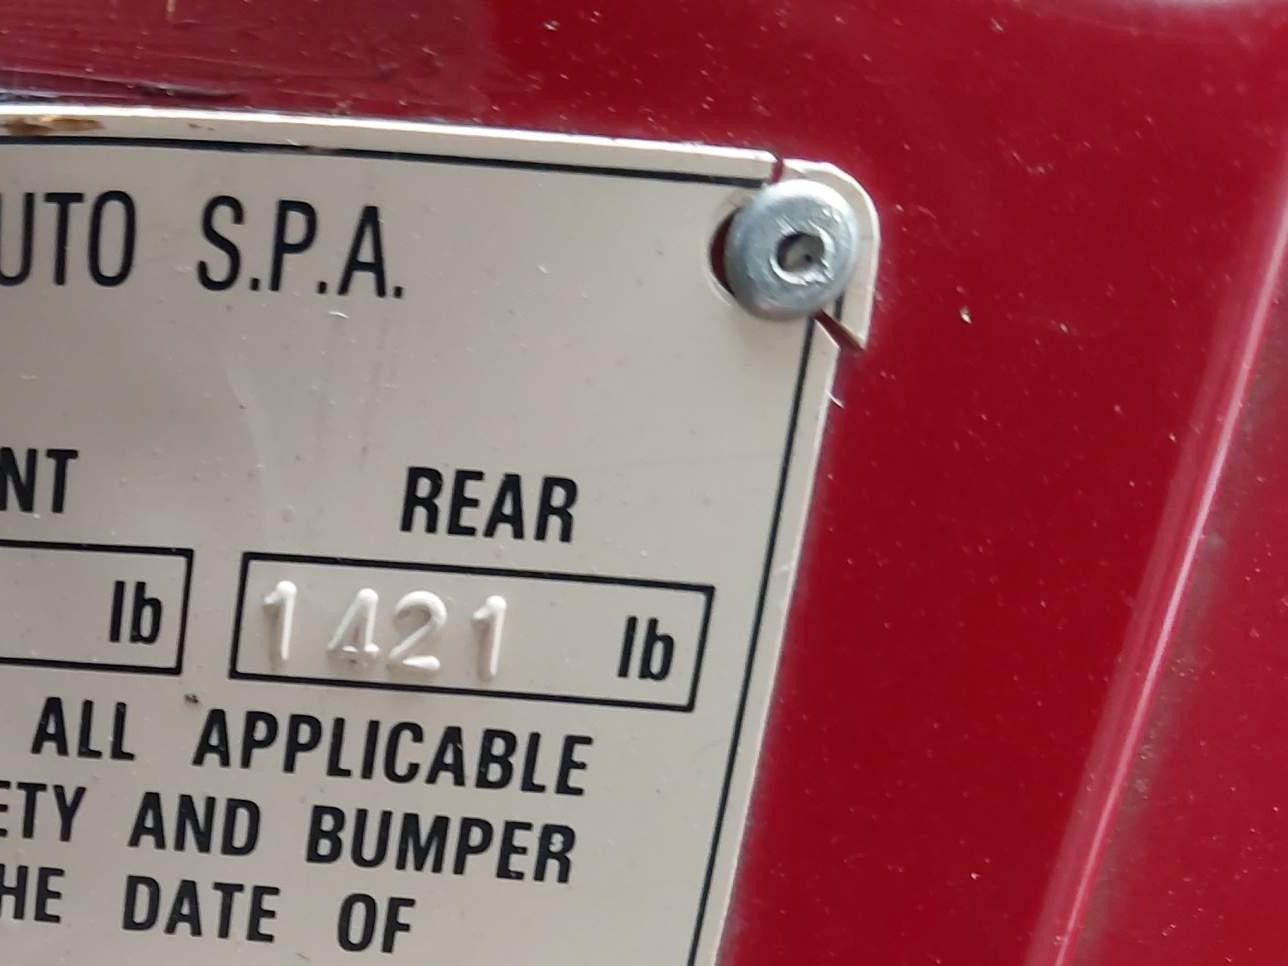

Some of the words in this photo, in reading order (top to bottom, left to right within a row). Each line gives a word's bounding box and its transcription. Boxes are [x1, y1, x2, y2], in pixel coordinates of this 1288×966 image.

[197, 195, 404, 299] S.P.A.
[400, 465, 579, 544] REAR
[109, 580, 162, 644] lb
[264, 580, 507, 677] 1421
[617, 616, 674, 682] lb
[31, 696, 135, 761] ALL
[192, 708, 593, 797] APPLICABLE
[128, 791, 260, 856] AND
[306, 803, 576, 884] BUMPER
[122, 875, 281, 944] DATE
[337, 892, 416, 955] OF
